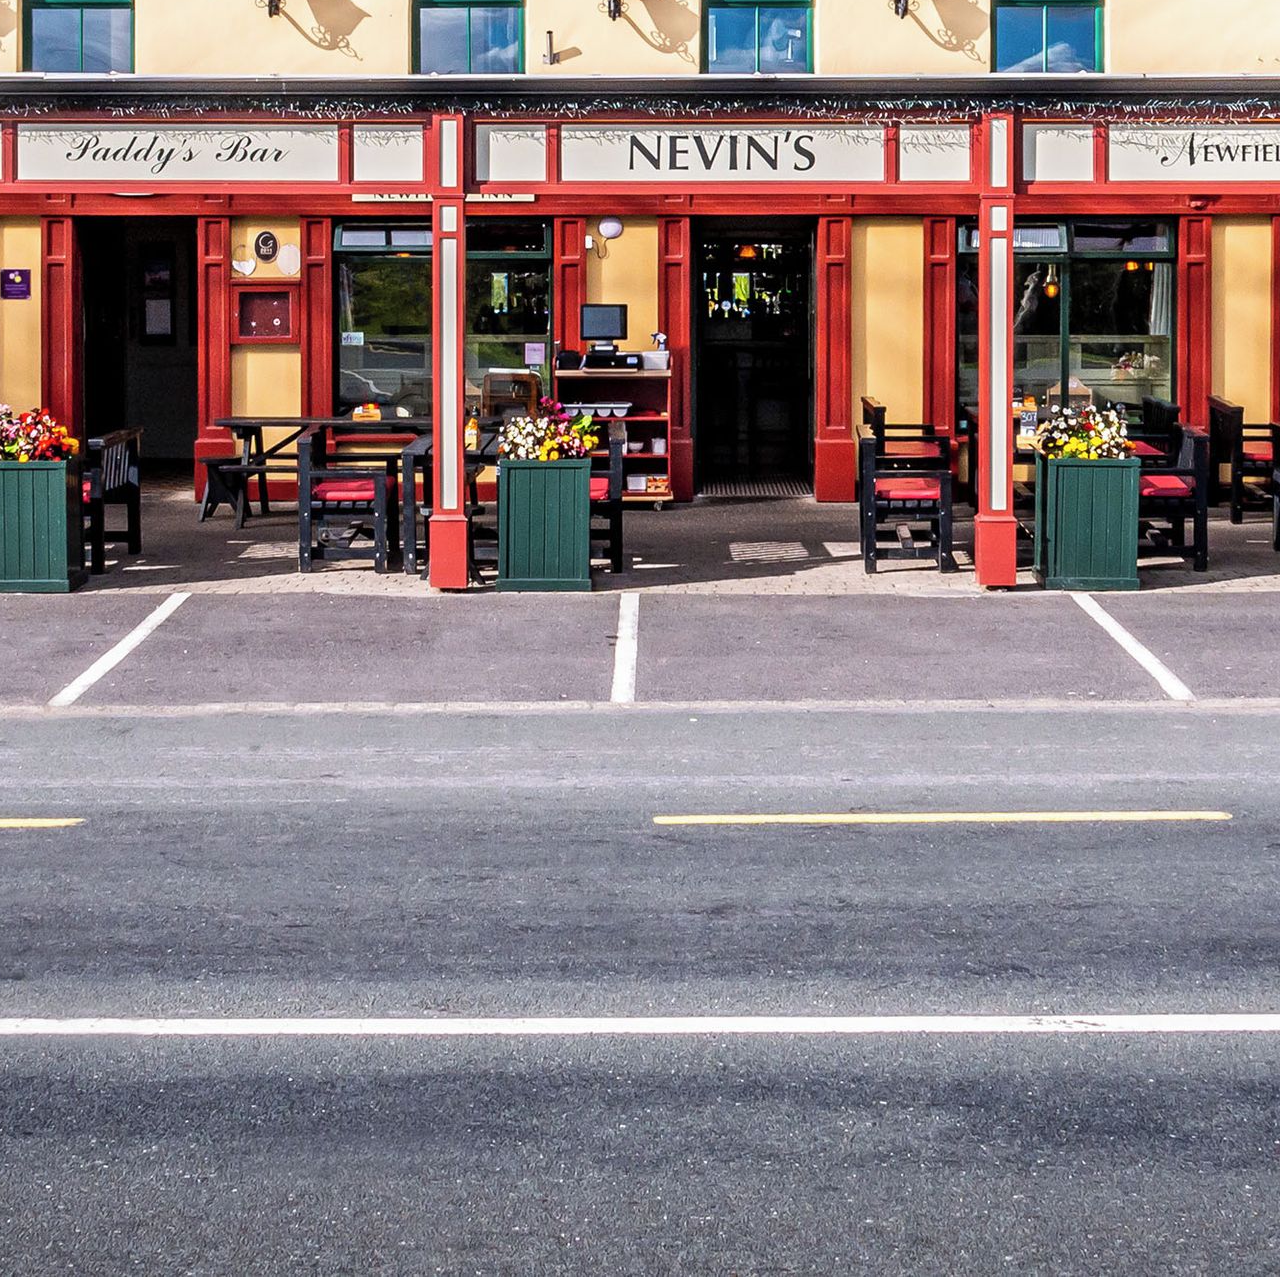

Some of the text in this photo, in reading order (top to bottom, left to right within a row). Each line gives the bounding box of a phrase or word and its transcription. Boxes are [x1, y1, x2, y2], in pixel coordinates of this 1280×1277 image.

[66, 134, 291, 174] Paddy's Bar
[628, 131, 816, 172] NEVIN'S
